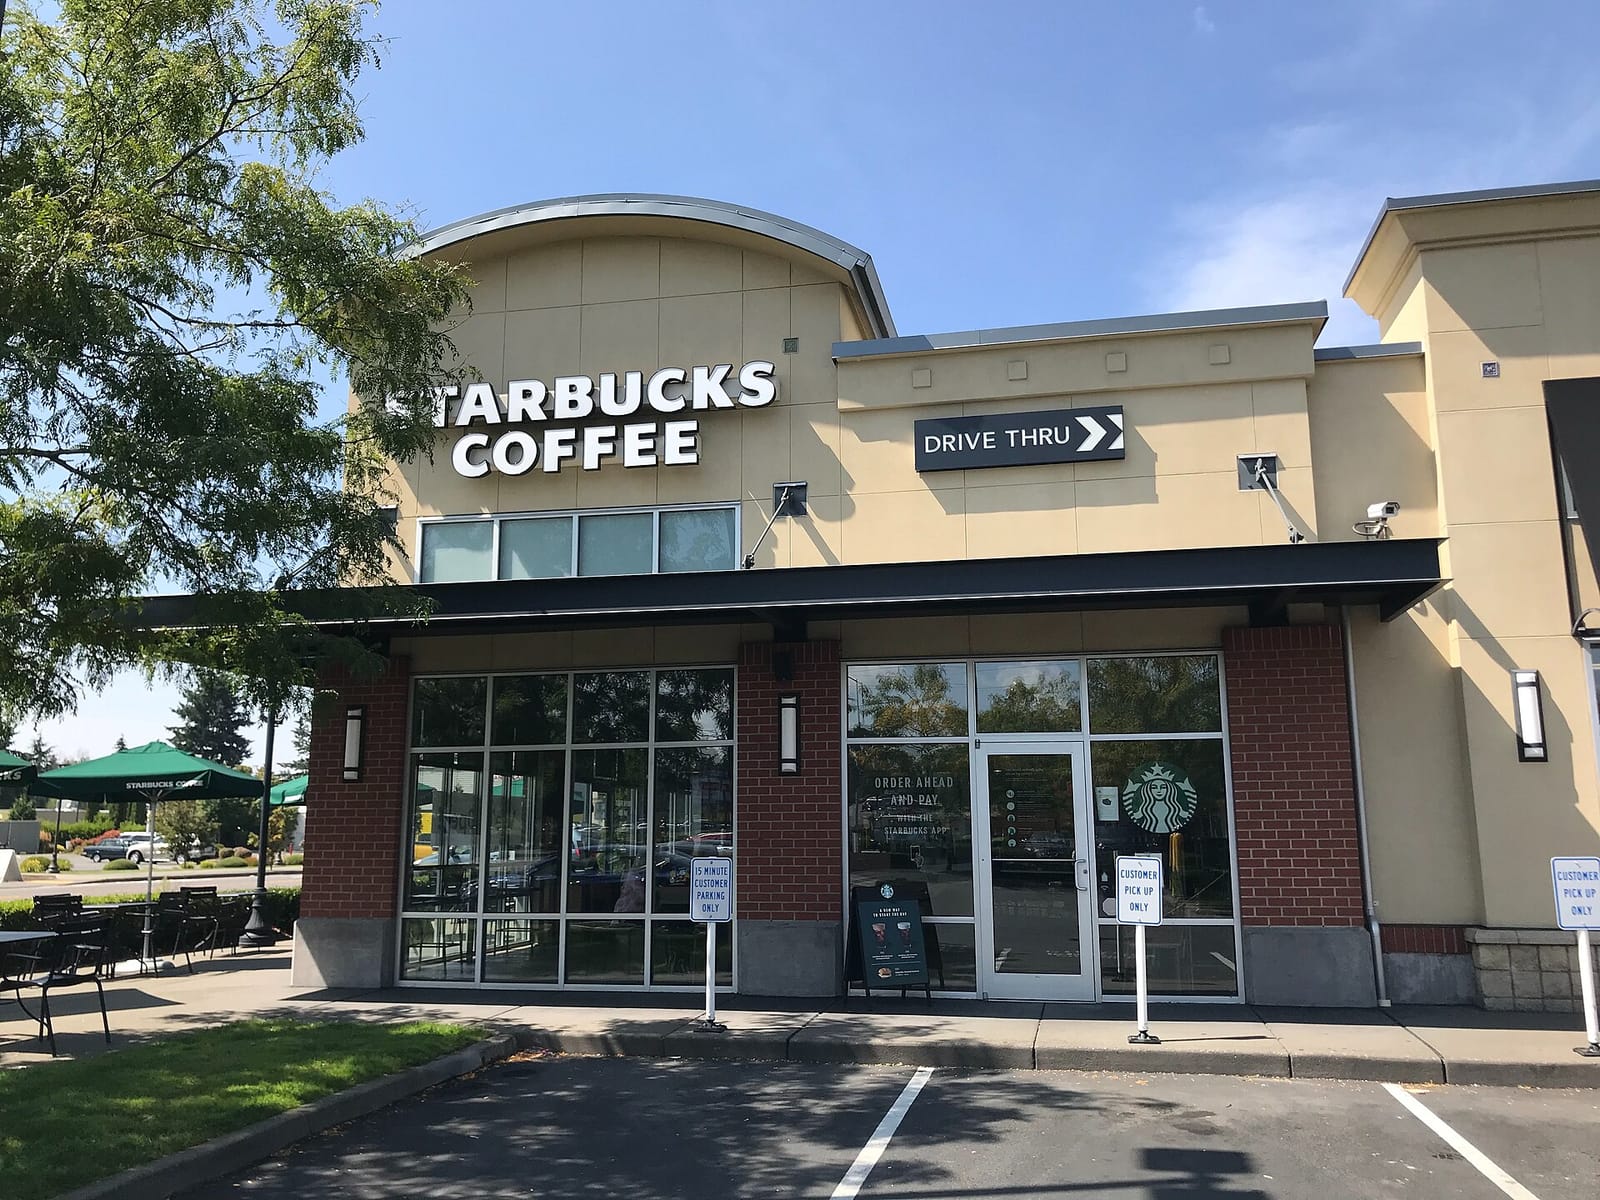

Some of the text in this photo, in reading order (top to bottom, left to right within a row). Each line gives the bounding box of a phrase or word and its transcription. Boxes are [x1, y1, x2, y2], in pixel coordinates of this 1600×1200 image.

[924, 426, 1070, 453] DRIVE THRU
[451, 420, 700, 478] COFFEE
[126, 780, 203, 789] STARBUCKS COEE
[875, 776, 953, 789] ORDER AHEAD
[891, 794, 938, 805] AND PAY
[884, 826, 947, 835] STARBUCKS APP
[695, 866, 728, 876] 15 MINUTE
[1120, 869, 1158, 880] CUSTOMER
[1557, 871, 1599, 881] CUSTOMER
[694, 879, 728, 888] CUSTOMER
[696, 891, 725, 900] PARKING
[1124, 885, 1154, 896] PICK UP
[1563, 888, 1596, 898] PICK UP
[702, 903, 720, 913] ONLY
[1129, 902, 1149, 912] ONLY
[1571, 905, 1592, 916] ONLY
